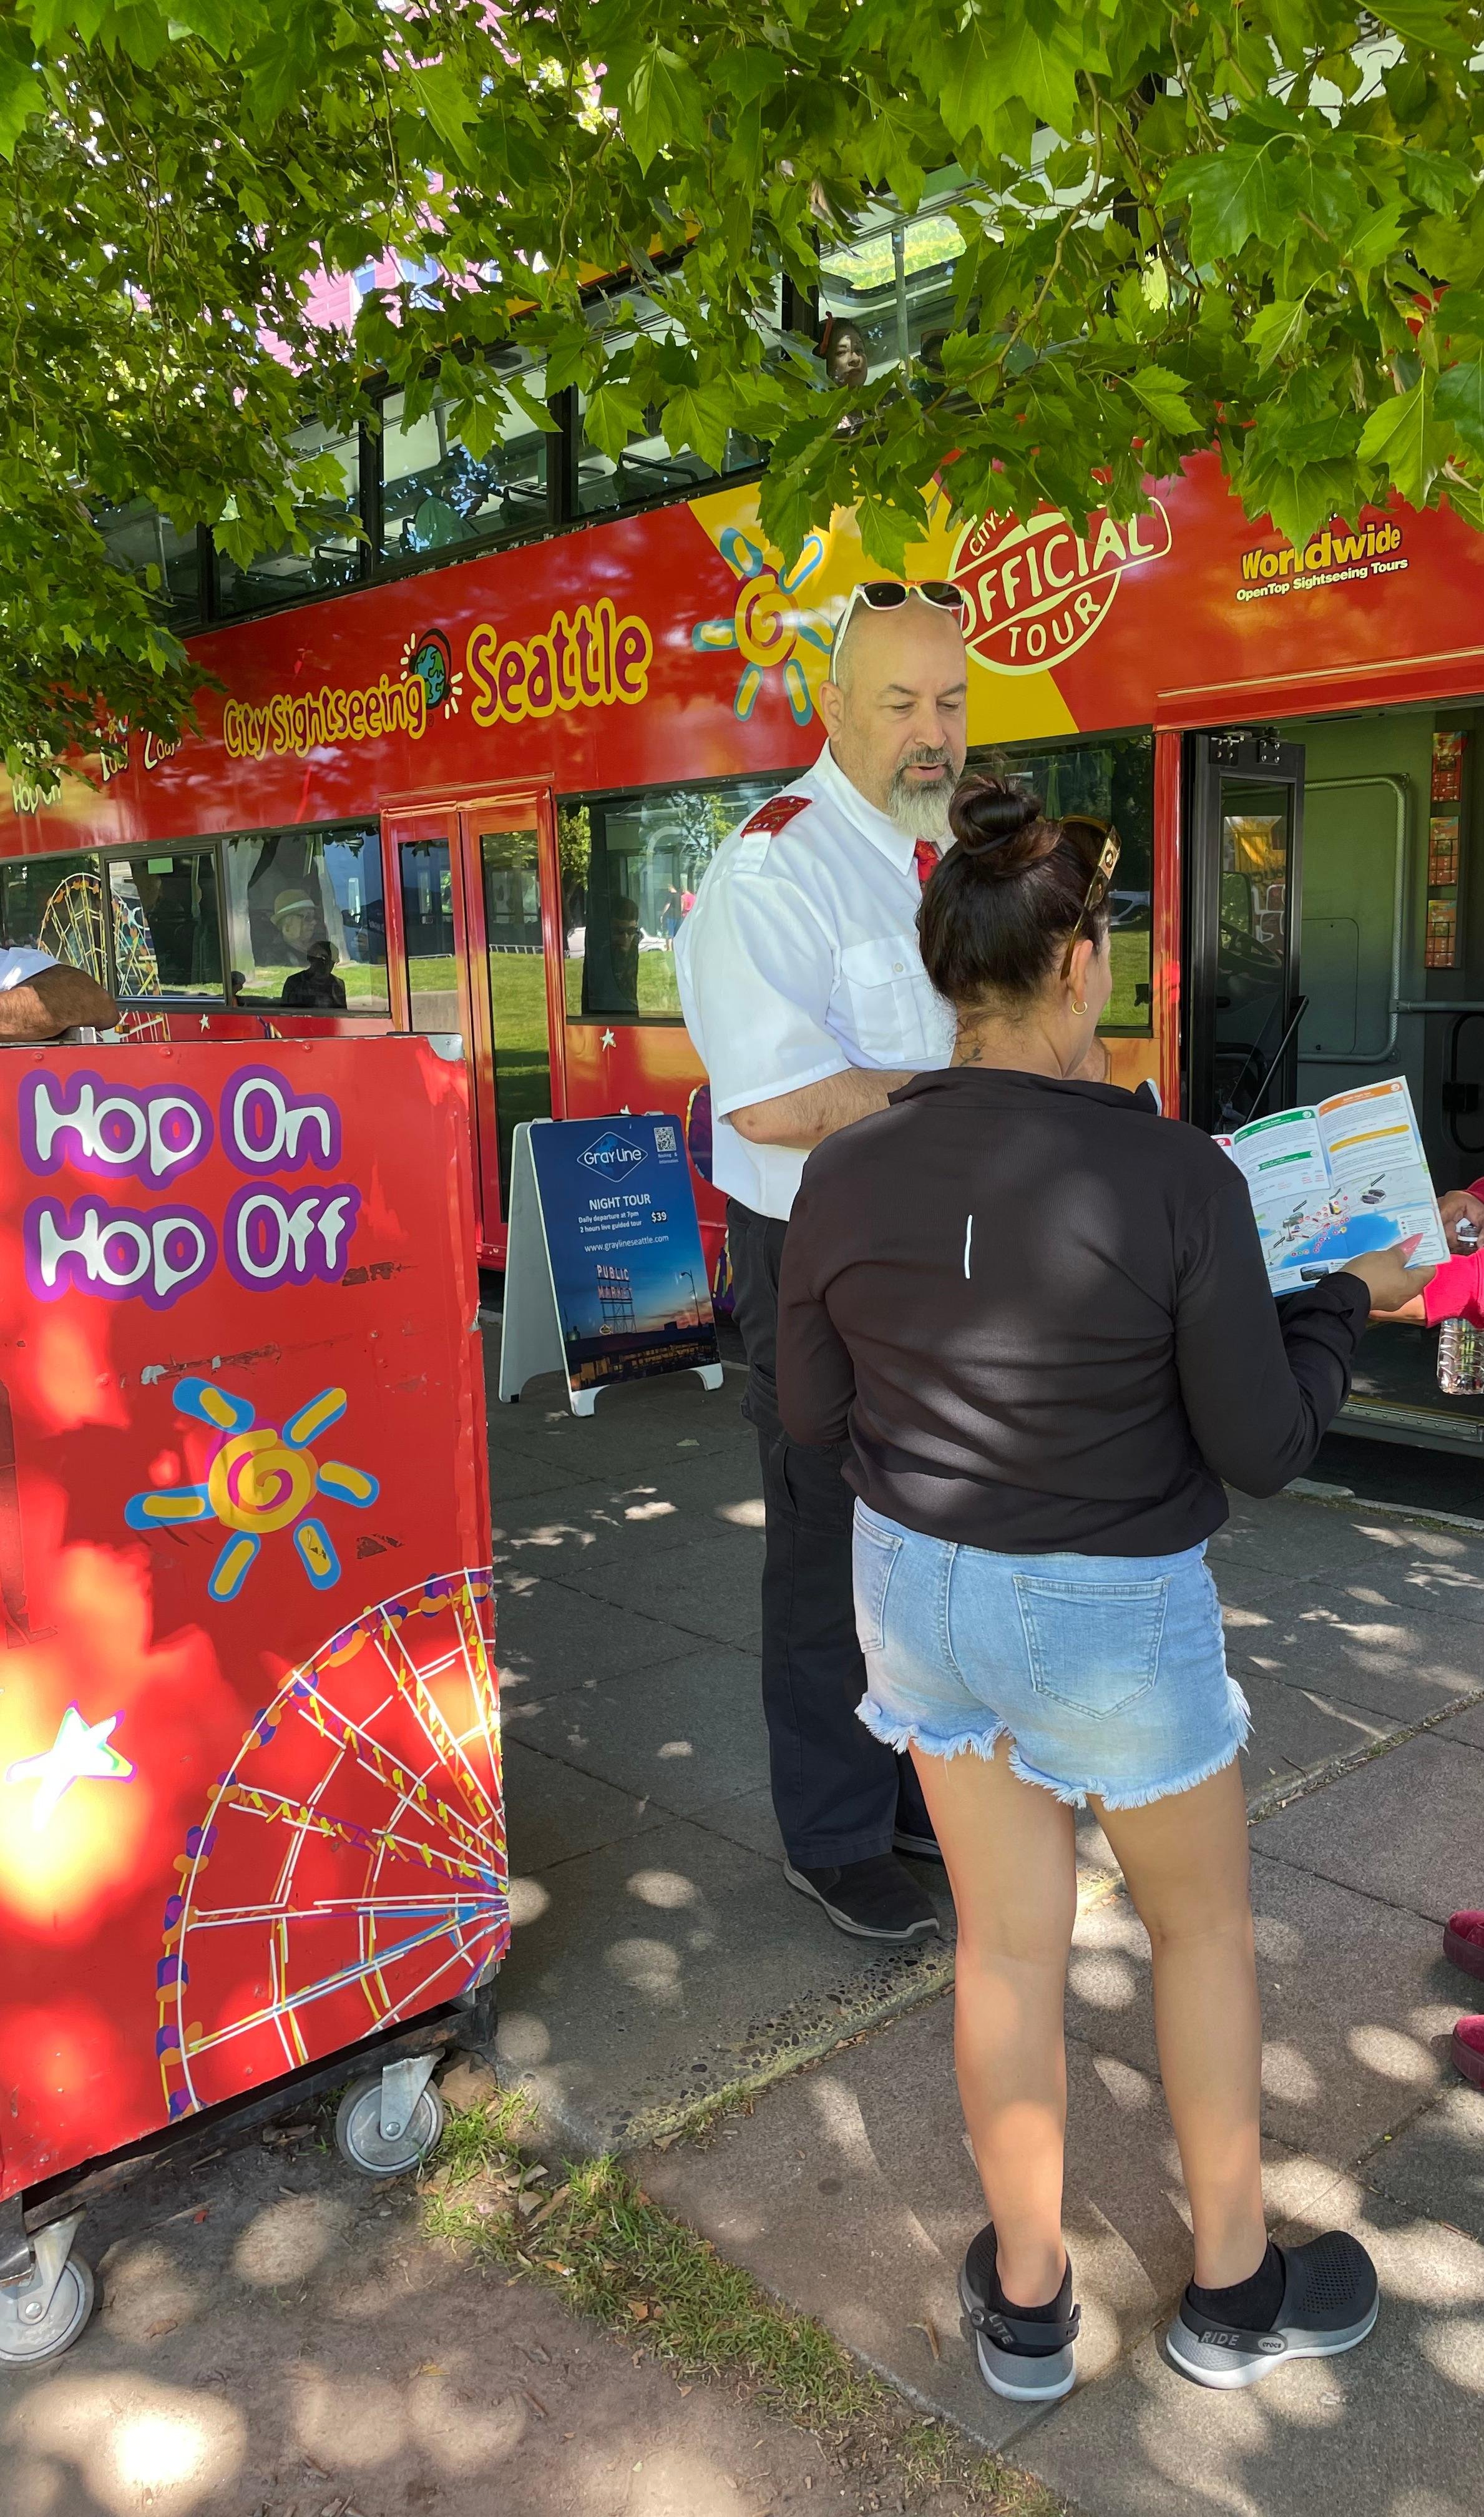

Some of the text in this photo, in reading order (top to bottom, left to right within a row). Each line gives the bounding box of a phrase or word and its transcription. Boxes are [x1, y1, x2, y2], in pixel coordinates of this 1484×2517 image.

[1236, 559, 1408, 601] OpenTop Sightseeing Tours
[1008, 592, 1101, 657] TOUR
[466, 597, 653, 727] Seattle
[31, 1074, 334, 1179] Hop On
[589, 1194, 652, 1210] NIGHT TOUR
[593, 1213, 620, 1222] departure
[612, 1221, 630, 1230] guided
[652, 1211, 667, 1223] $39
[36, 1192, 354, 1300] Hop Off
[584, 1235, 669, 1252] www.graylineseattle.com
[597, 1264, 630, 1280] PUBLIC
[989, 2314, 1013, 2345] LITE
[1201, 2331, 1239, 2346] RIDE
